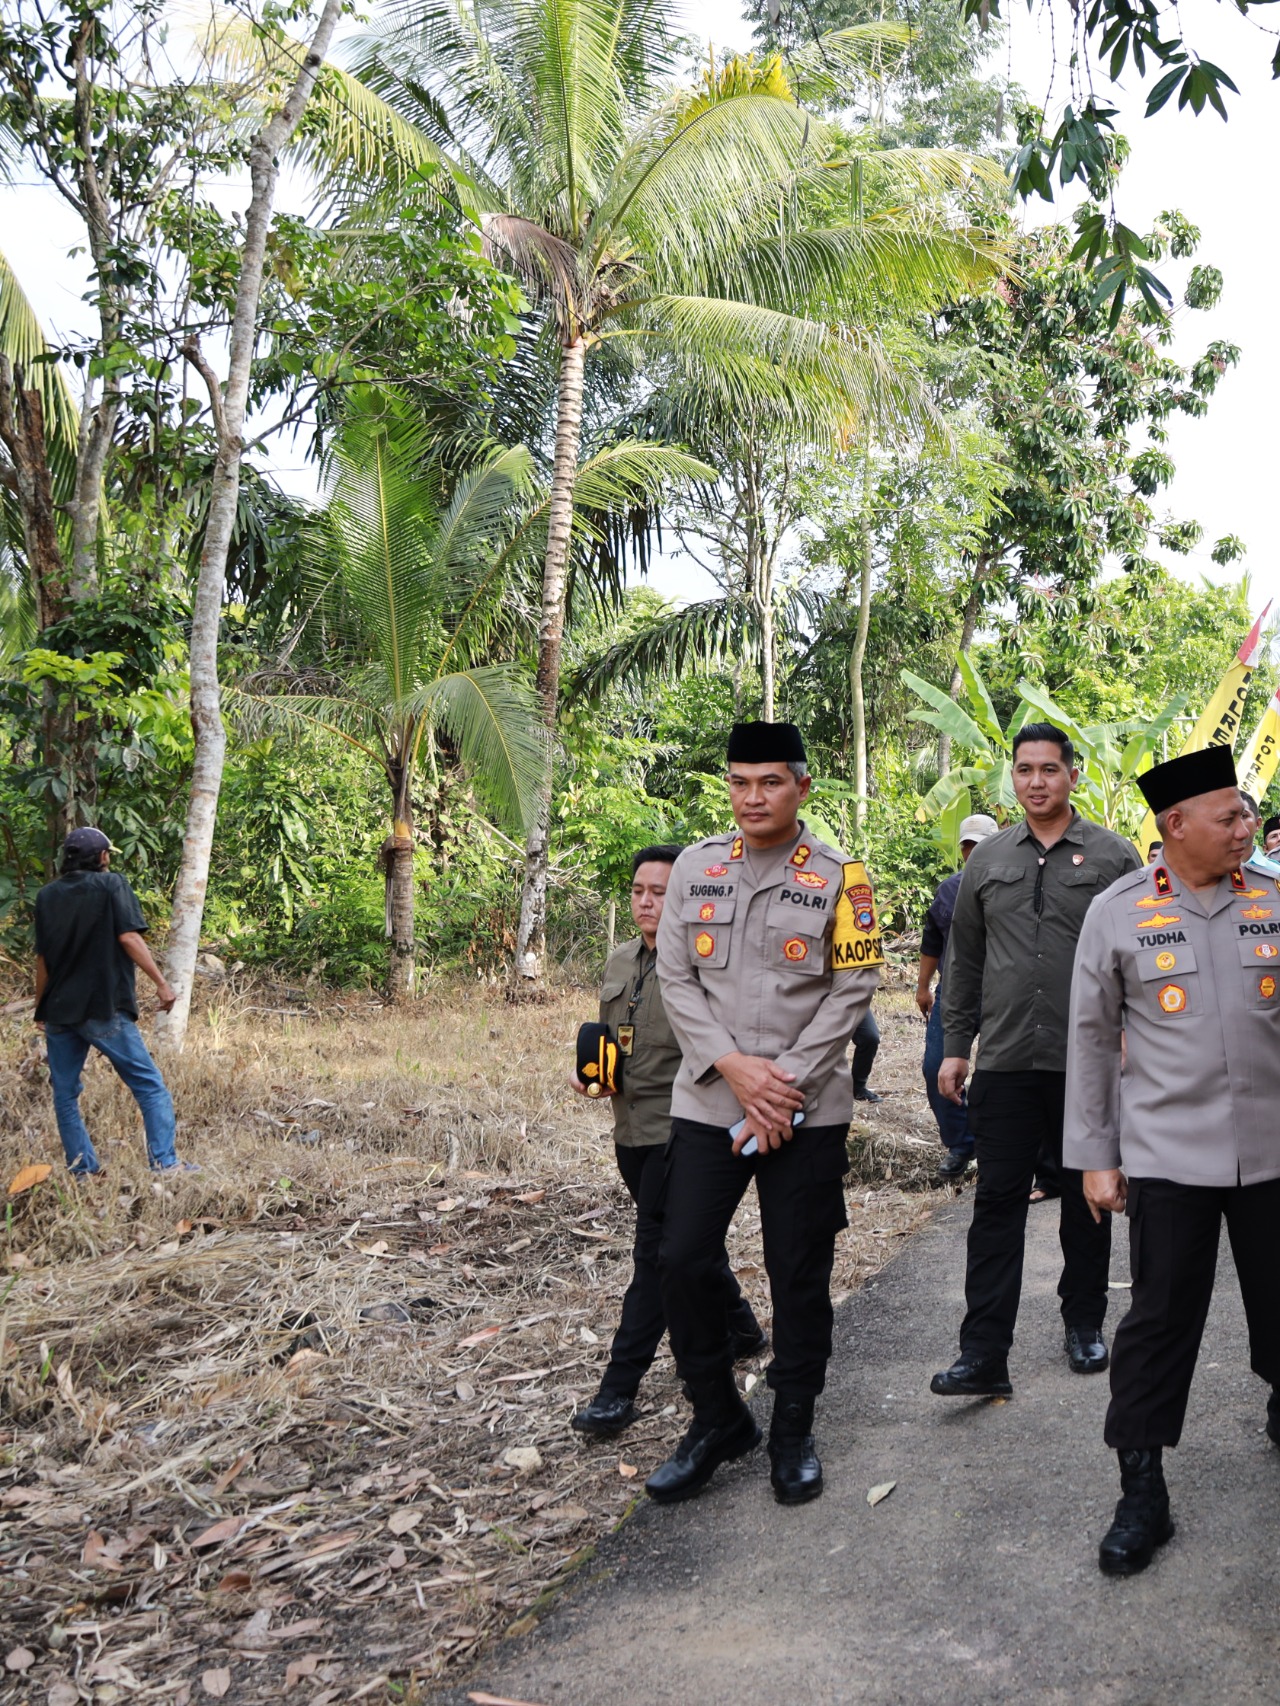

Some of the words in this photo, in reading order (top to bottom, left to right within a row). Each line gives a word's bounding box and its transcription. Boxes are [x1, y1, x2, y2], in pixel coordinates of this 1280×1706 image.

[1240, 735, 1276, 792] POLRES
[689, 884, 734, 898] SUGENG.P
[780, 889, 827, 910] POLRI
[1137, 931, 1186, 947] YUDHA
